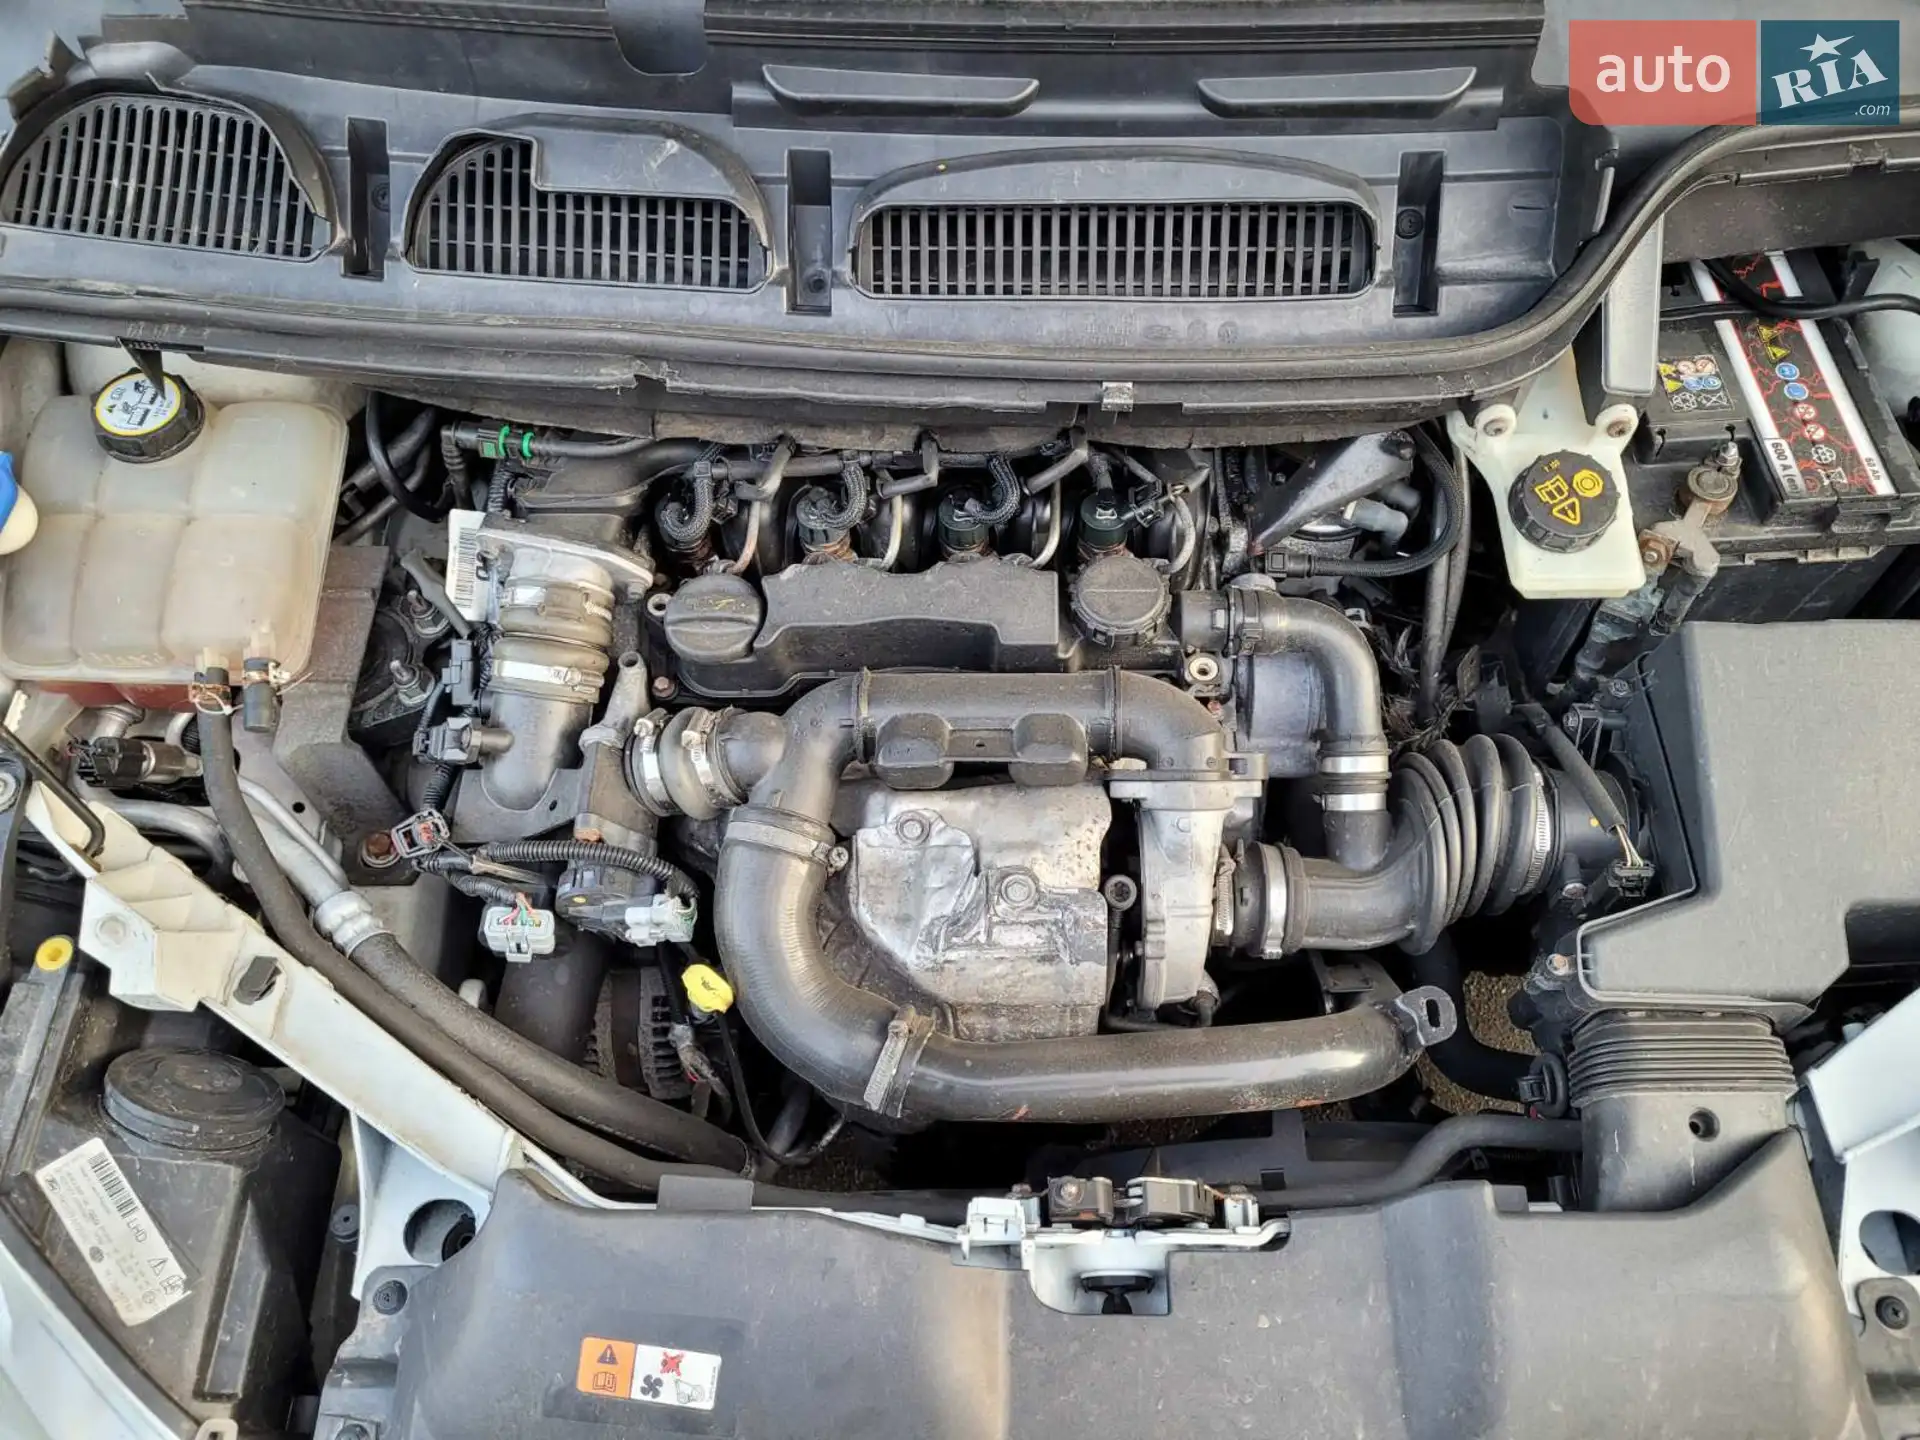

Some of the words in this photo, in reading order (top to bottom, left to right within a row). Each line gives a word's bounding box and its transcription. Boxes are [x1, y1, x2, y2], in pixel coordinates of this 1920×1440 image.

[1771, 442, 1788, 460] 600
[1782, 474, 1801, 494] (en)
[126, 1218, 148, 1243] LHD
